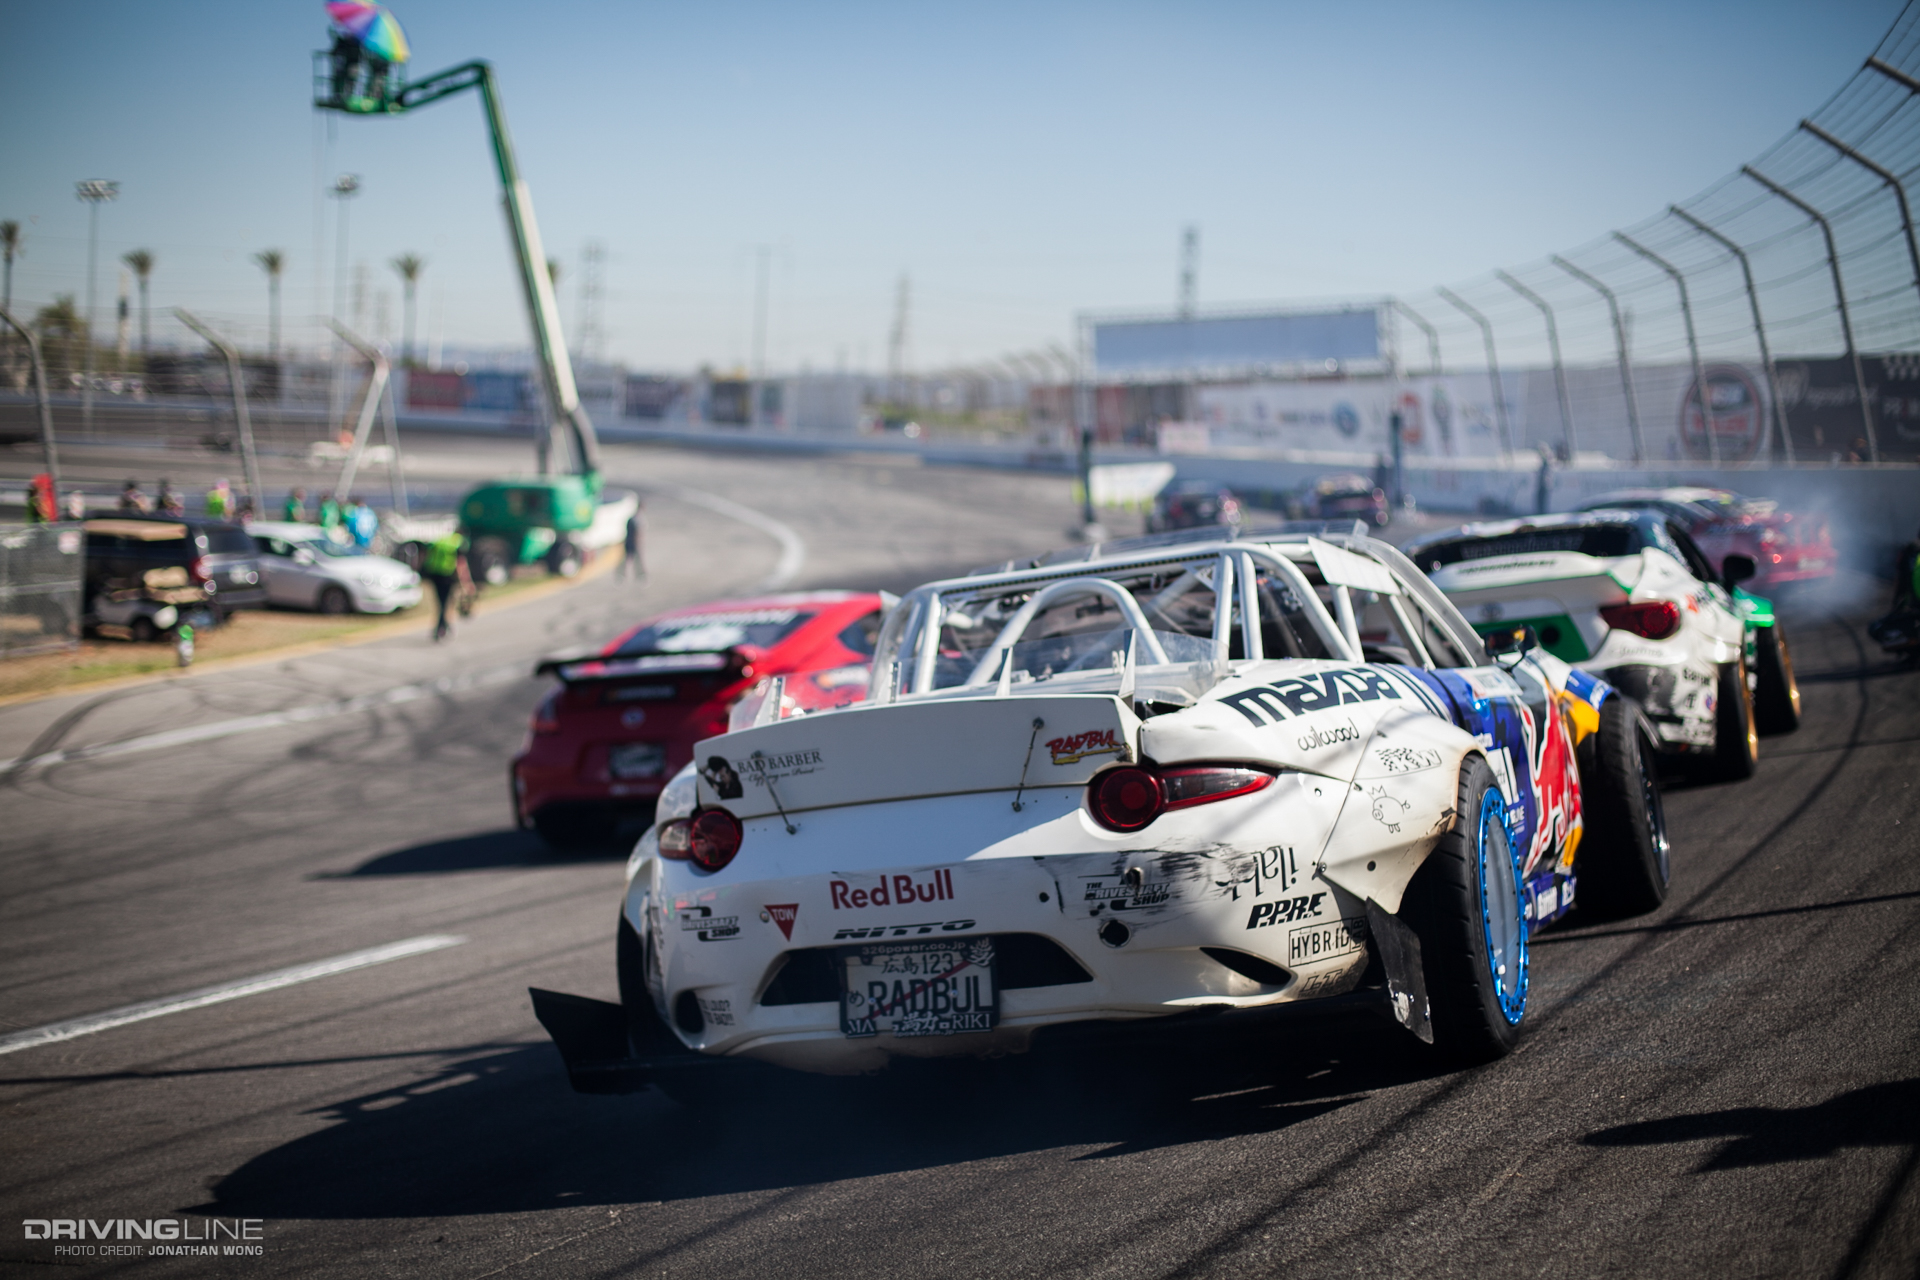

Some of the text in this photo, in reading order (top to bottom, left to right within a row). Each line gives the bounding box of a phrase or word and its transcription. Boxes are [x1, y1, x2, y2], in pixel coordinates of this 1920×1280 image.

[1216, 667, 1402, 728] mazda
[1045, 729, 1120, 758] RADBUL
[1298, 718, 1360, 751] wilwood
[737, 751, 823, 774] BAD BARBER
[830, 868, 954, 910] Red Bull
[771, 908, 795, 921] TOW
[833, 919, 977, 940] NITTO
[1291, 926, 1350, 960] HYBRID
[861, 941, 967, 955] 326power.co.jp
[922, 952, 954, 974] 123
[867, 975, 993, 1017] RADBUL
